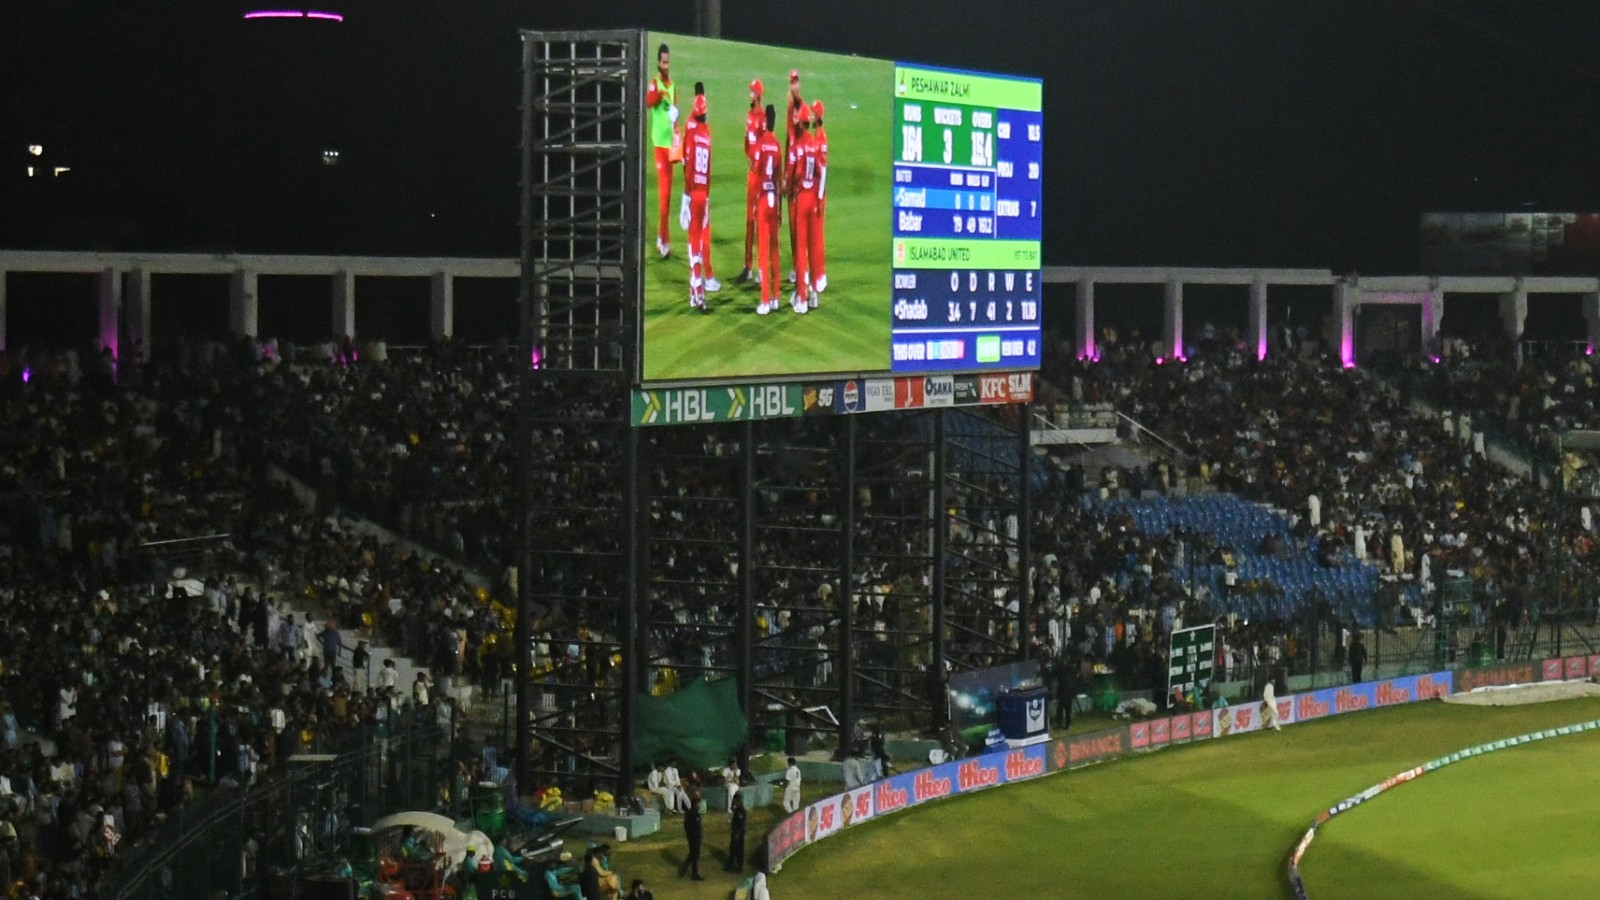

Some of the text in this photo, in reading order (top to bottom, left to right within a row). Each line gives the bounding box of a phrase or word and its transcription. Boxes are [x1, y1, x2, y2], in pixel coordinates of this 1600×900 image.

[911, 77, 971, 98] PESHAWAR ZALMI
[943, 128, 953, 164] 3
[955, 194, 961, 210] 0
[968, 194, 975, 210] 0
[899, 210, 923, 232] Babar
[909, 246, 970, 262] ISLAMABAD UNITED
[951, 272, 959, 292] O
[969, 272, 978, 292] D
[988, 272, 995, 292] R
[1005, 273, 1014, 291] W
[1026, 272, 1033, 291] E
[898, 298, 928, 320] Shadab
[970, 302, 977, 321] 7
[1006, 301, 1013, 321] 2
[925, 377, 952, 396] OSAKA
[981, 377, 1006, 398] KFC
[666, 389, 715, 423] HBL
[750, 386, 795, 417] HBL
